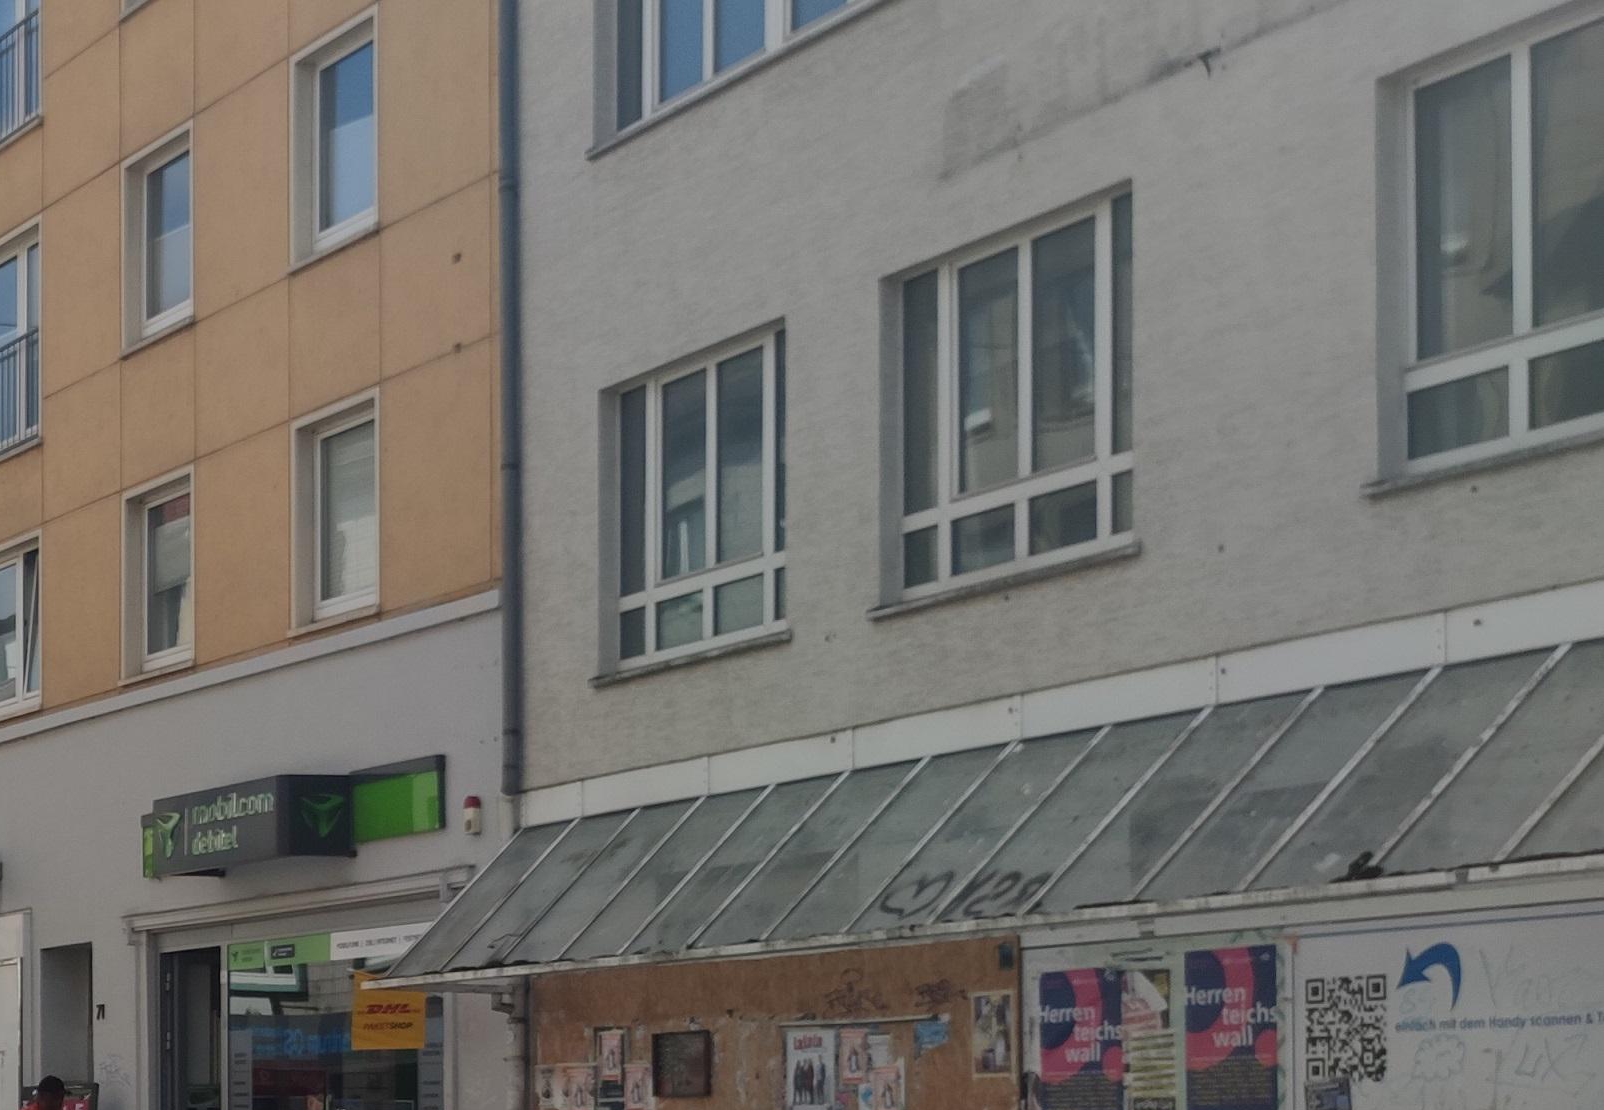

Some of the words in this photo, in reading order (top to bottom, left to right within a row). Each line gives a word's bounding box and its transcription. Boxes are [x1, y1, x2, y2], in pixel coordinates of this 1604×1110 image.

[192, 825, 239, 856] debitel
[1185, 986, 1247, 1006] Herren
[365, 1003, 411, 1015] DHL
[1040, 1004, 1097, 1024] Herren
[1222, 1002, 1278, 1026] teichs
[1439, 1017, 1457, 1030] mit
[1459, 1016, 1486, 1030] dem
[1489, 1016, 1526, 1031] Handy
[1530, 1013, 1582, 1026] scannen
[1212, 1026, 1253, 1047] wall
[1065, 1043, 1101, 1062] wall
